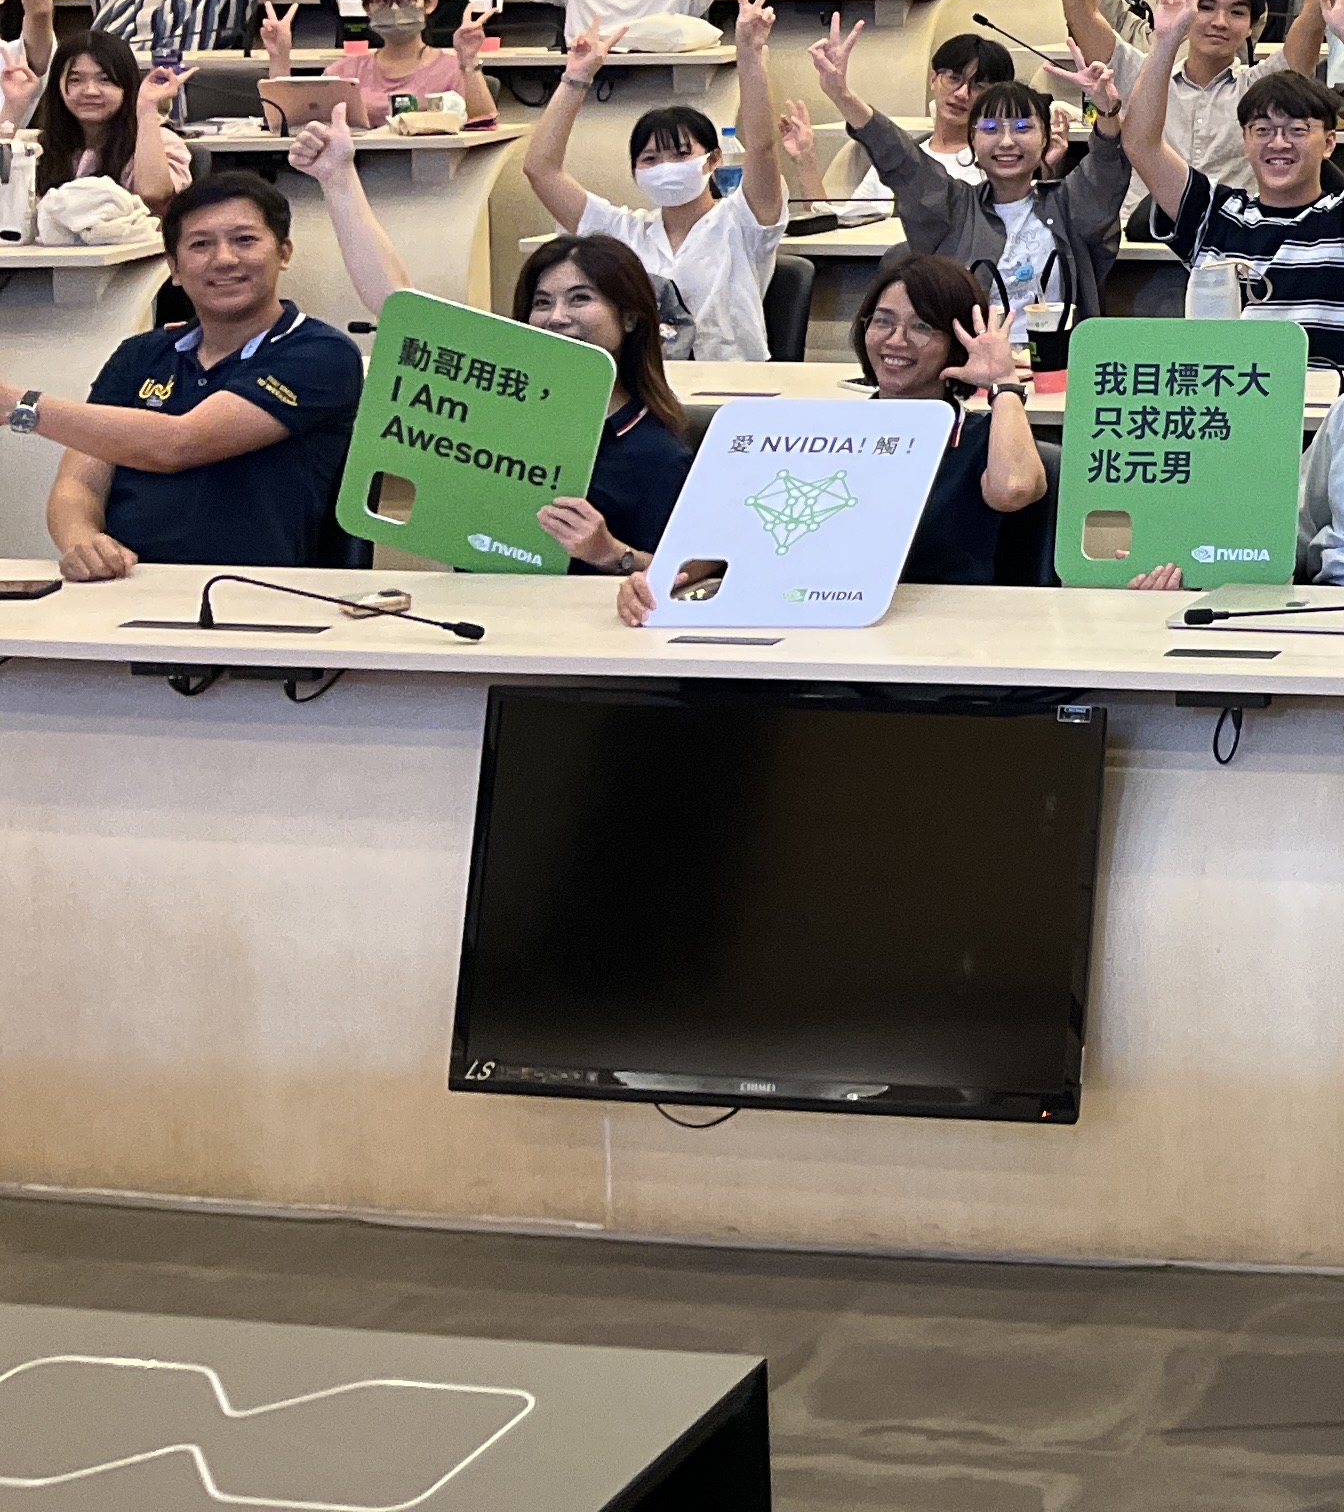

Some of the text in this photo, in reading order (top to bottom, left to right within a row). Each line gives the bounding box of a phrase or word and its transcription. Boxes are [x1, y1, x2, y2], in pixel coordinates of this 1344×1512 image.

[1093, 361, 1272, 398] 我目標不大
[390, 375, 470, 424] I Am
[1091, 405, 1232, 441] 只求成為
[380, 414, 562, 491] Awesome!
[1087, 448, 1193, 485] 兆元男
